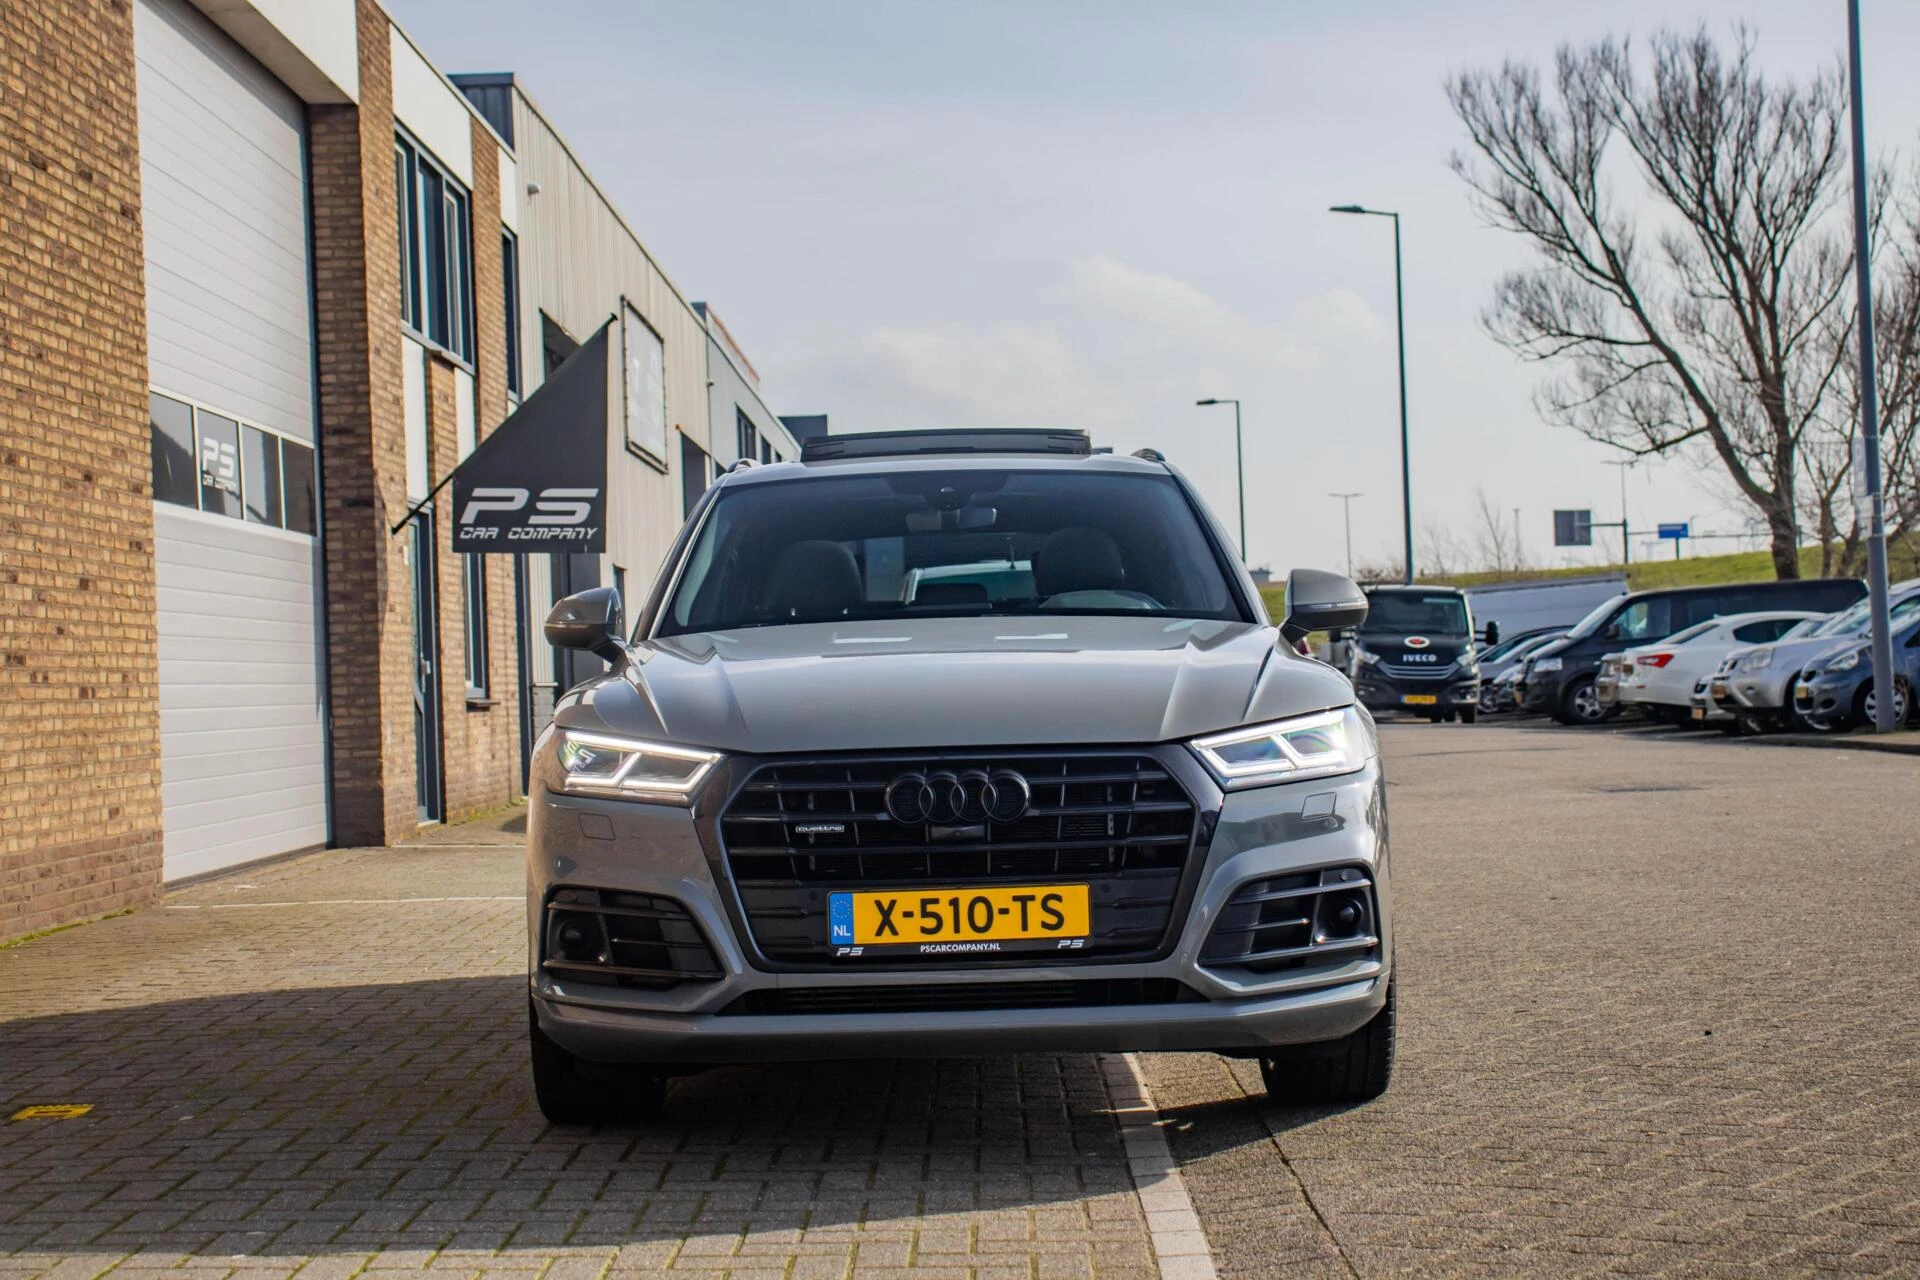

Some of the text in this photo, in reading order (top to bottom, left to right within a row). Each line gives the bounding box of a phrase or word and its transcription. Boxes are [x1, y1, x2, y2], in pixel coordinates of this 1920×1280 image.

[202, 436, 235, 478] PS
[460, 488, 599, 524] PS
[459, 527, 598, 540] CAR COMPANY
[1403, 654, 1437, 662] IVECO
[874, 893, 1064, 937] X-510-TS
[833, 925, 851, 937] NL
[920, 943, 1001, 953] PSCARCOMPANY.NL
[1057, 940, 1085, 949] PS
[836, 947, 864, 956] PS
